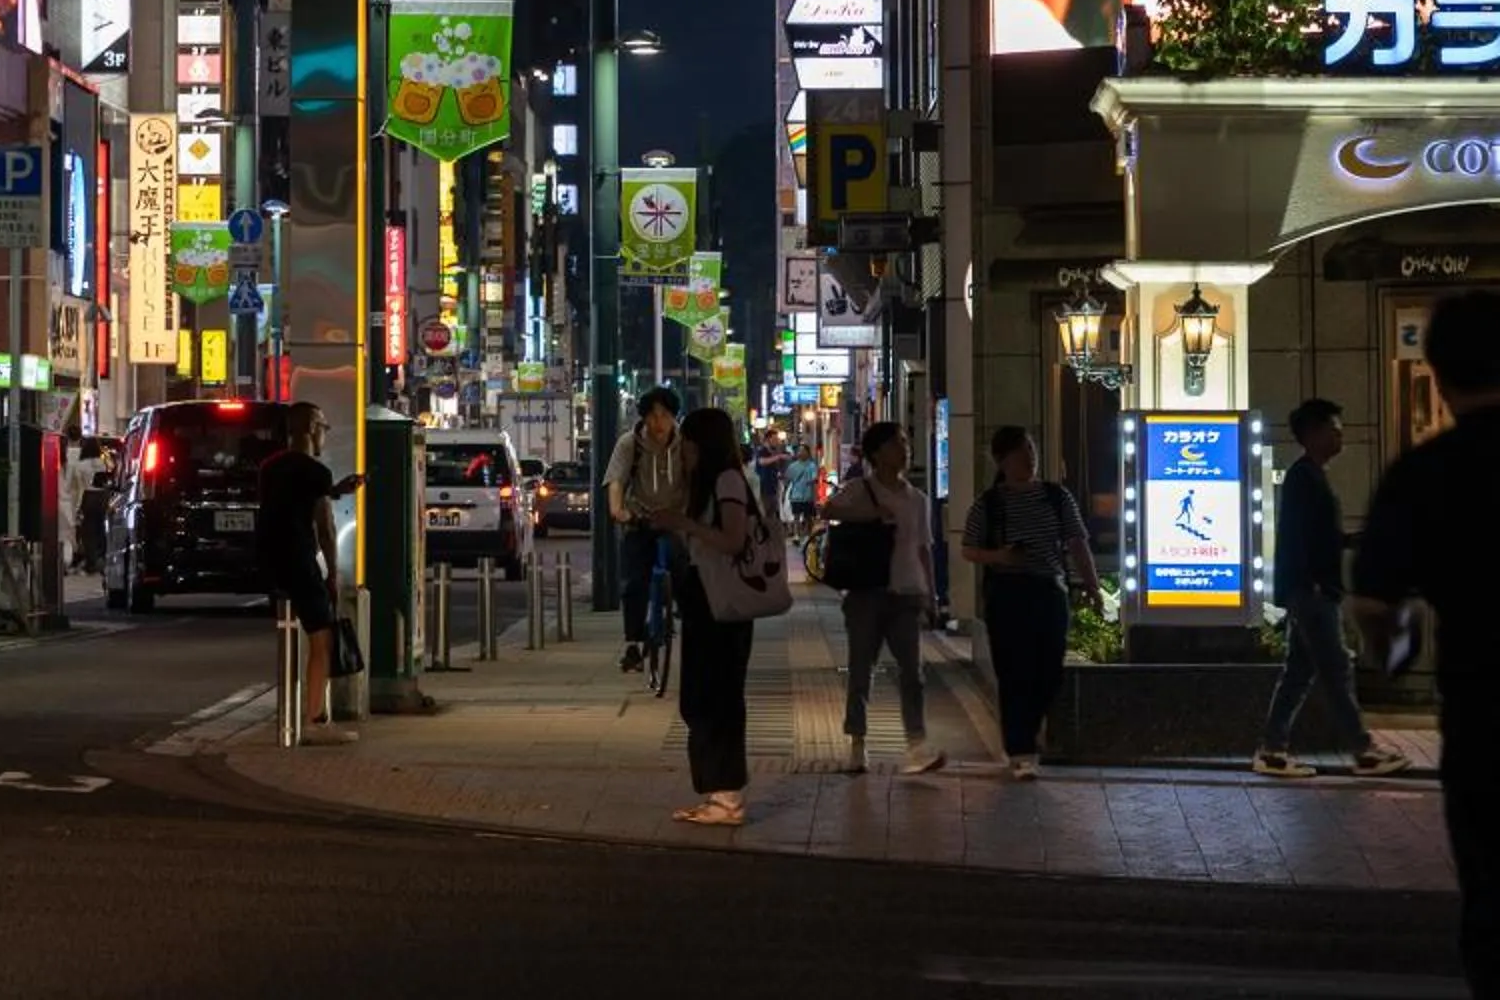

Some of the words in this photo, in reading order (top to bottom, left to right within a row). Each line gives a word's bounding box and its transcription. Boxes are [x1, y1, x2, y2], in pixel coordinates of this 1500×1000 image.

[104, 51, 125, 68] 3F
[4, 151, 34, 191] P
[831, 134, 876, 210] P
[135, 160, 163, 238] 大魔王
[141, 247, 158, 332] HOUSE
[143, 341, 166, 358] 1F
[1163, 430, 1220, 444] カラオケ
